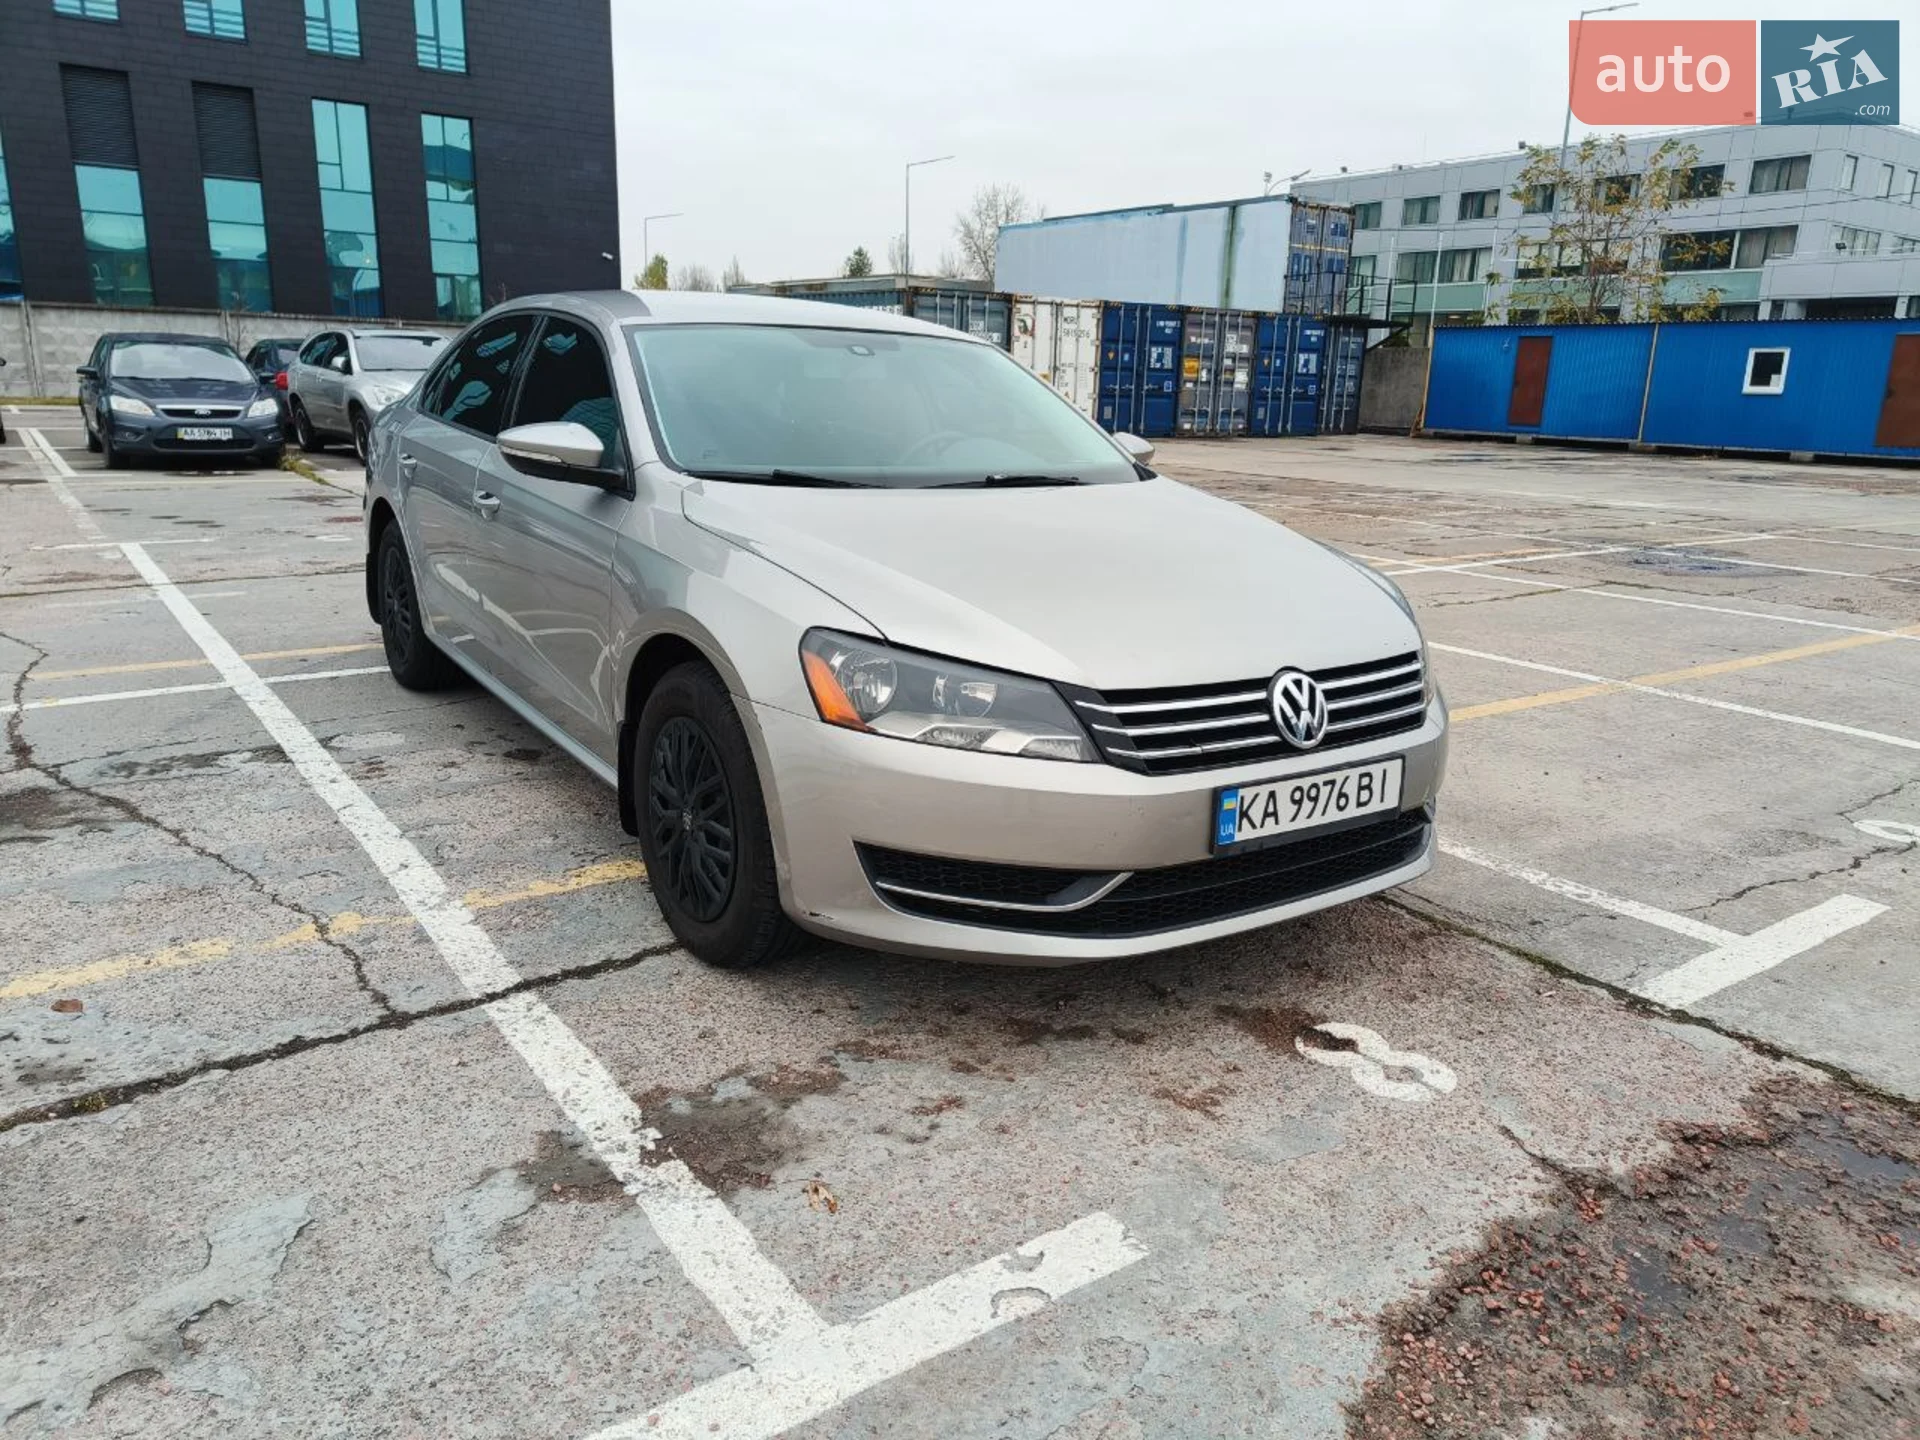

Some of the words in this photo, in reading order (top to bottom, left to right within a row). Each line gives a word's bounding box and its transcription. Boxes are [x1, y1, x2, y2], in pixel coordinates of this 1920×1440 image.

[1237, 790, 1279, 832] KA
[1289, 775, 1350, 822] 9976
[1356, 769, 1387, 809] BI
[1220, 823, 1234, 836] UA
